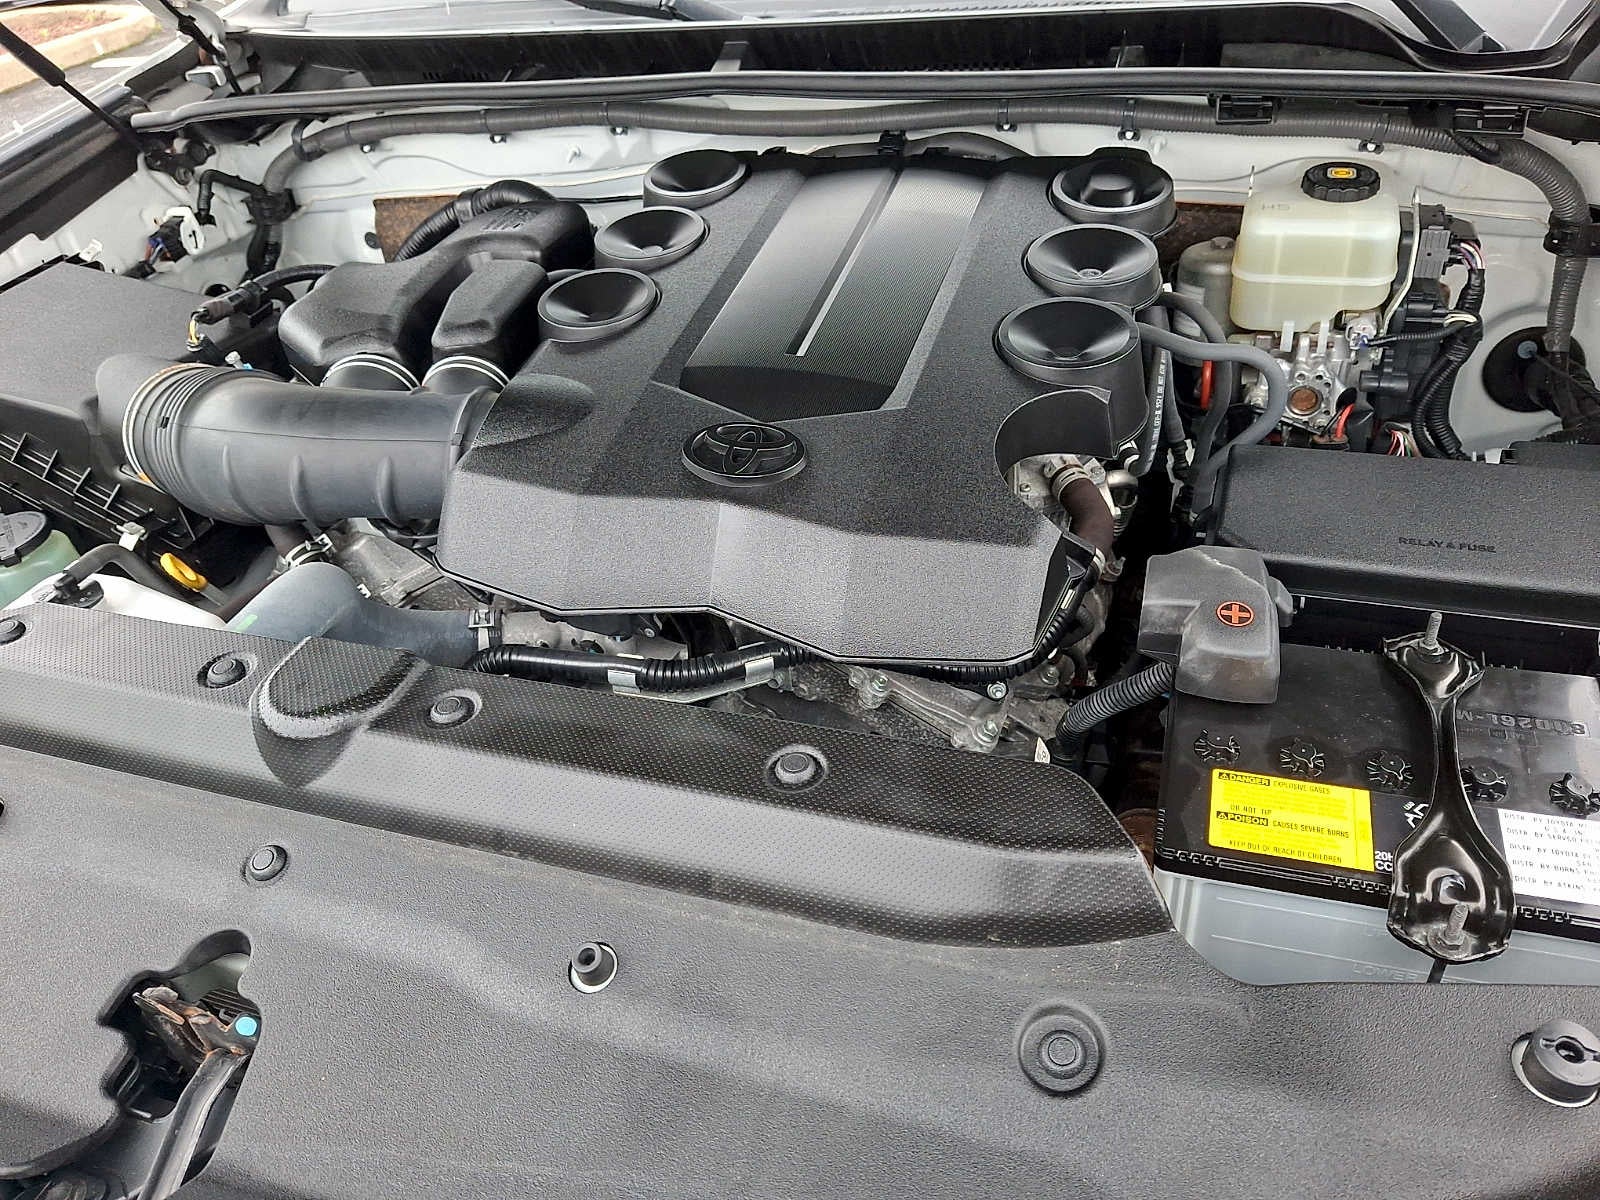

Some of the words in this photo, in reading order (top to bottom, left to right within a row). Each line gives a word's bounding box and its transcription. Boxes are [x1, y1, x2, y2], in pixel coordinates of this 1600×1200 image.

[1399, 536, 1444, 549] RELAY
[1459, 543, 1497, 554] FUSE
[1229, 774, 1270, 787] DANGER
[1272, 780, 1307, 792] EXPLOSIVE
[1309, 785, 1331, 795] GASES
[1227, 813, 1268, 827] POISON
[1272, 820, 1299, 831] CAUSES
[1300, 824, 1325, 835] SEVERE
[1327, 828, 1350, 839] BURNS
[1273, 846, 1295, 856] REACH
[1307, 851, 1342, 864] CHILDREN
